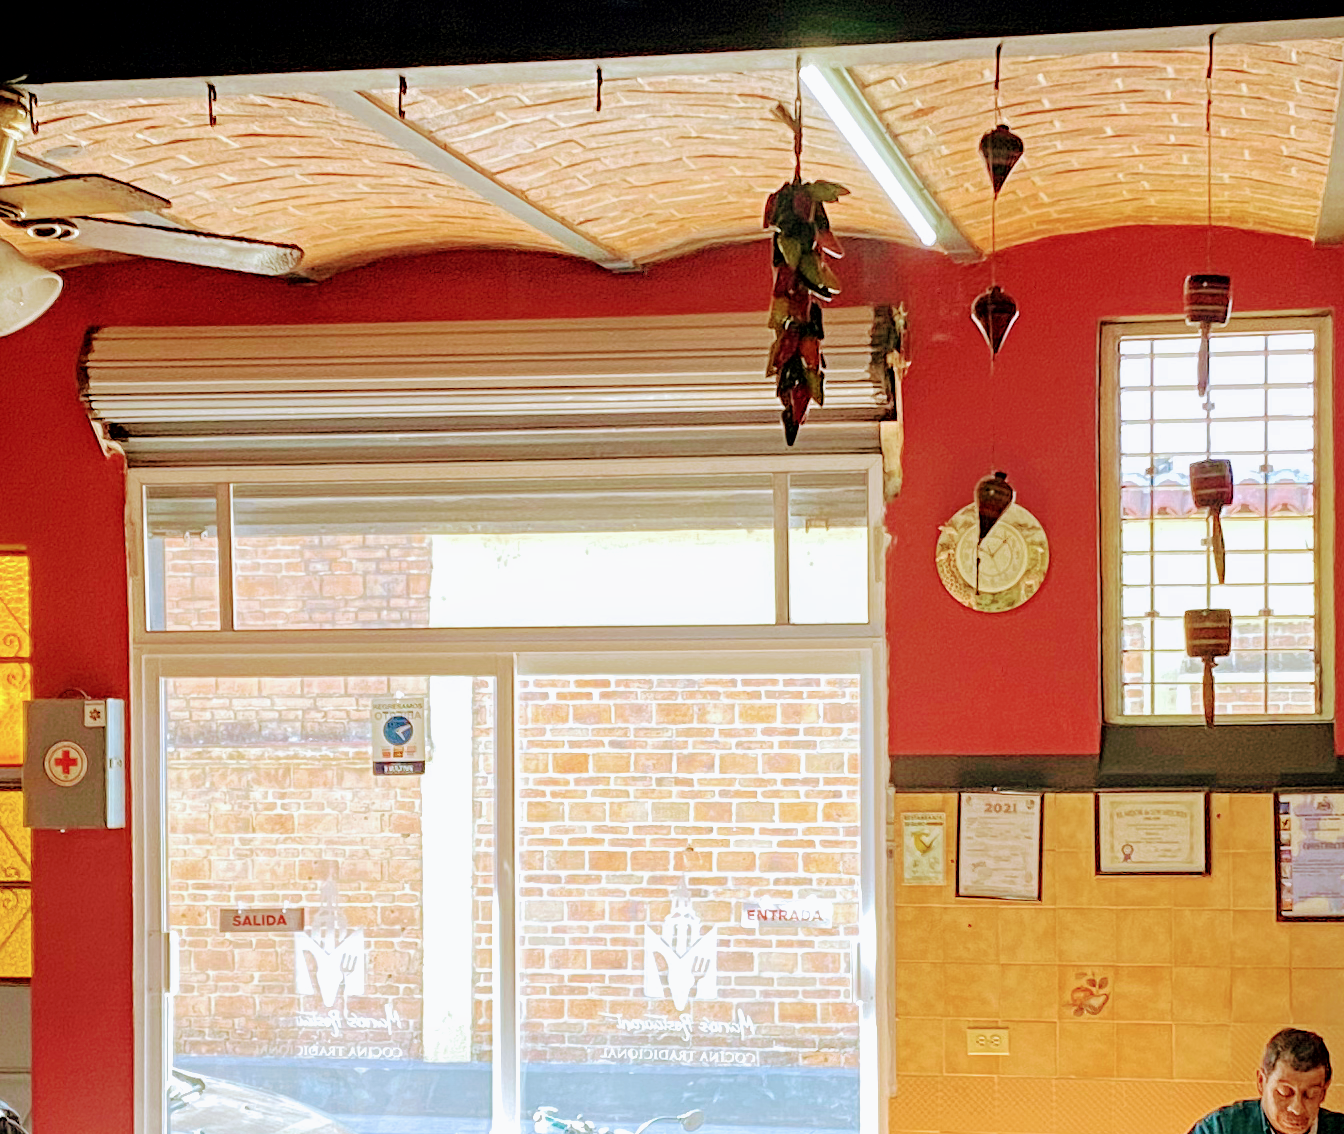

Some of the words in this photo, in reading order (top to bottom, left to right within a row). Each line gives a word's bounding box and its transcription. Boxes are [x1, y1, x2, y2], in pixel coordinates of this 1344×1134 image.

[984, 803, 1017, 813] 2021
[232, 914, 287, 927] SALIDA
[747, 909, 824, 922] ENTRADA
